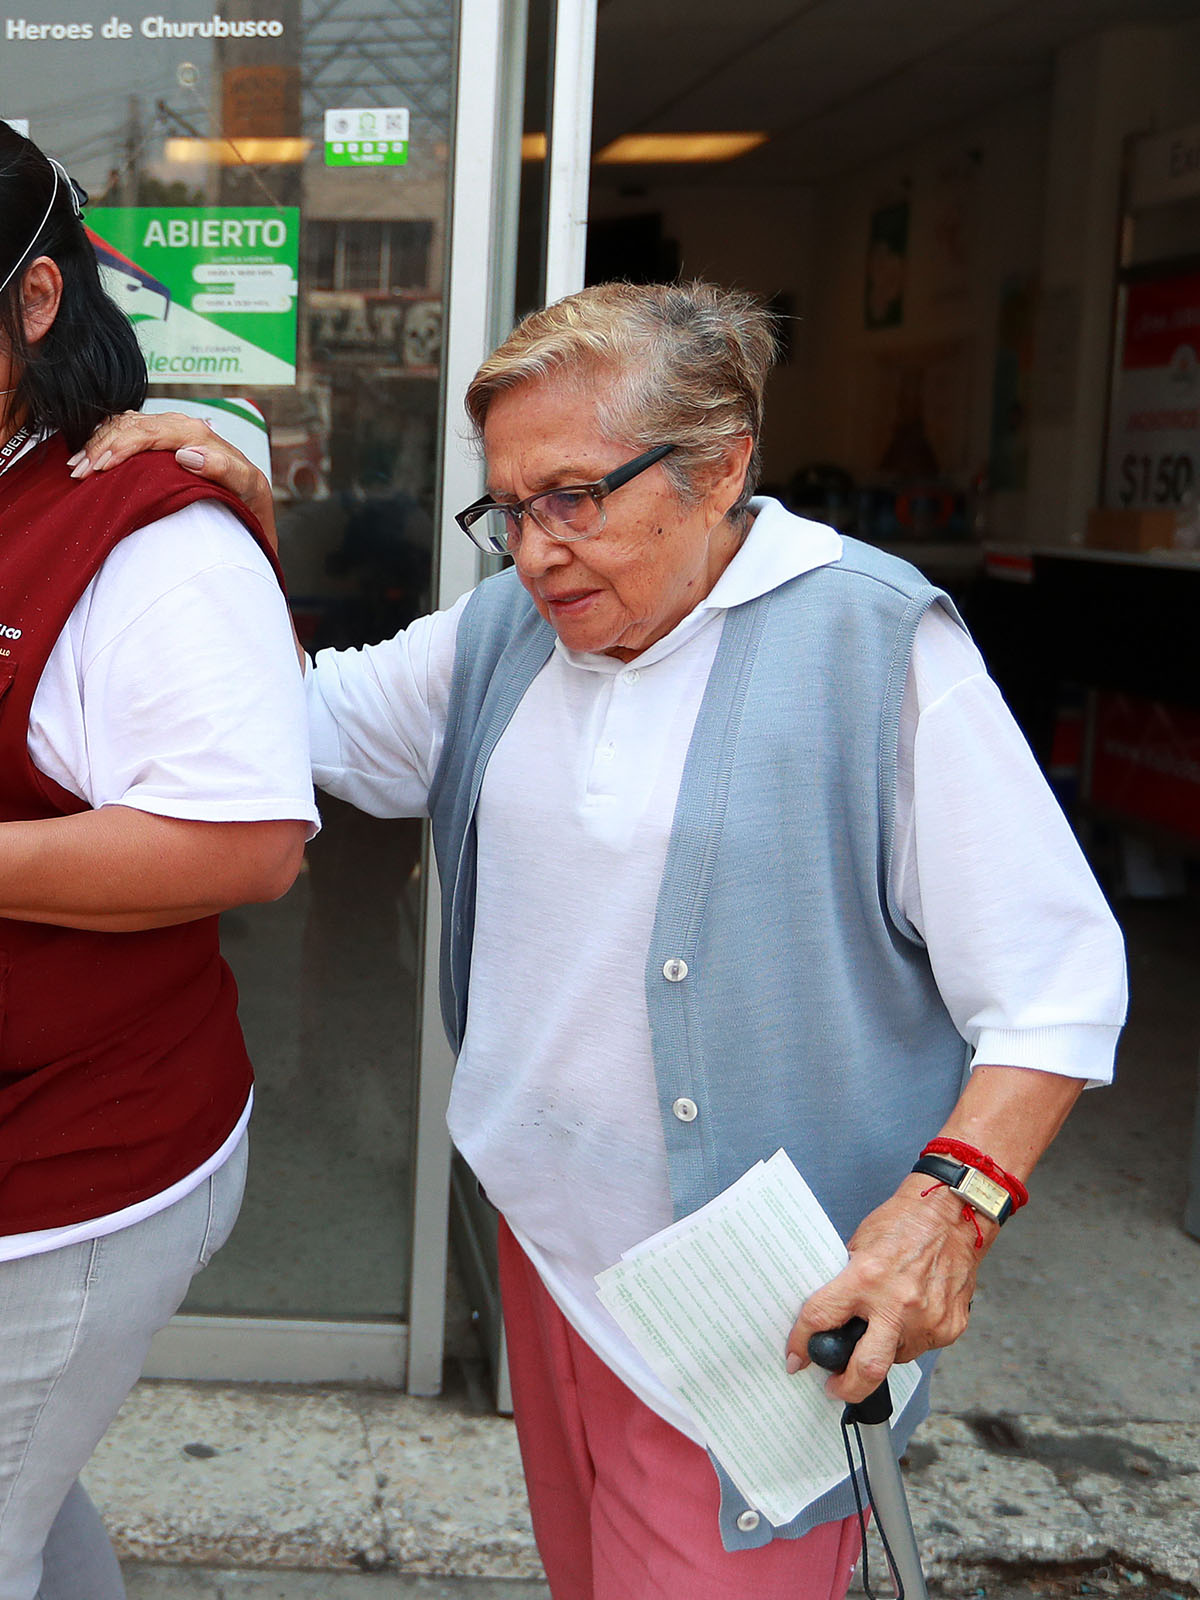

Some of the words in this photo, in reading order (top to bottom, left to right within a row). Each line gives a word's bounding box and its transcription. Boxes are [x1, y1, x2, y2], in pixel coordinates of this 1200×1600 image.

[5, 18, 94, 40] Heroes
[101, 16, 133, 39] de
[141, 15, 284, 38] Churubusco
[143, 219, 287, 248] ABIERTO
[148, 351, 243, 373] lecomm.
